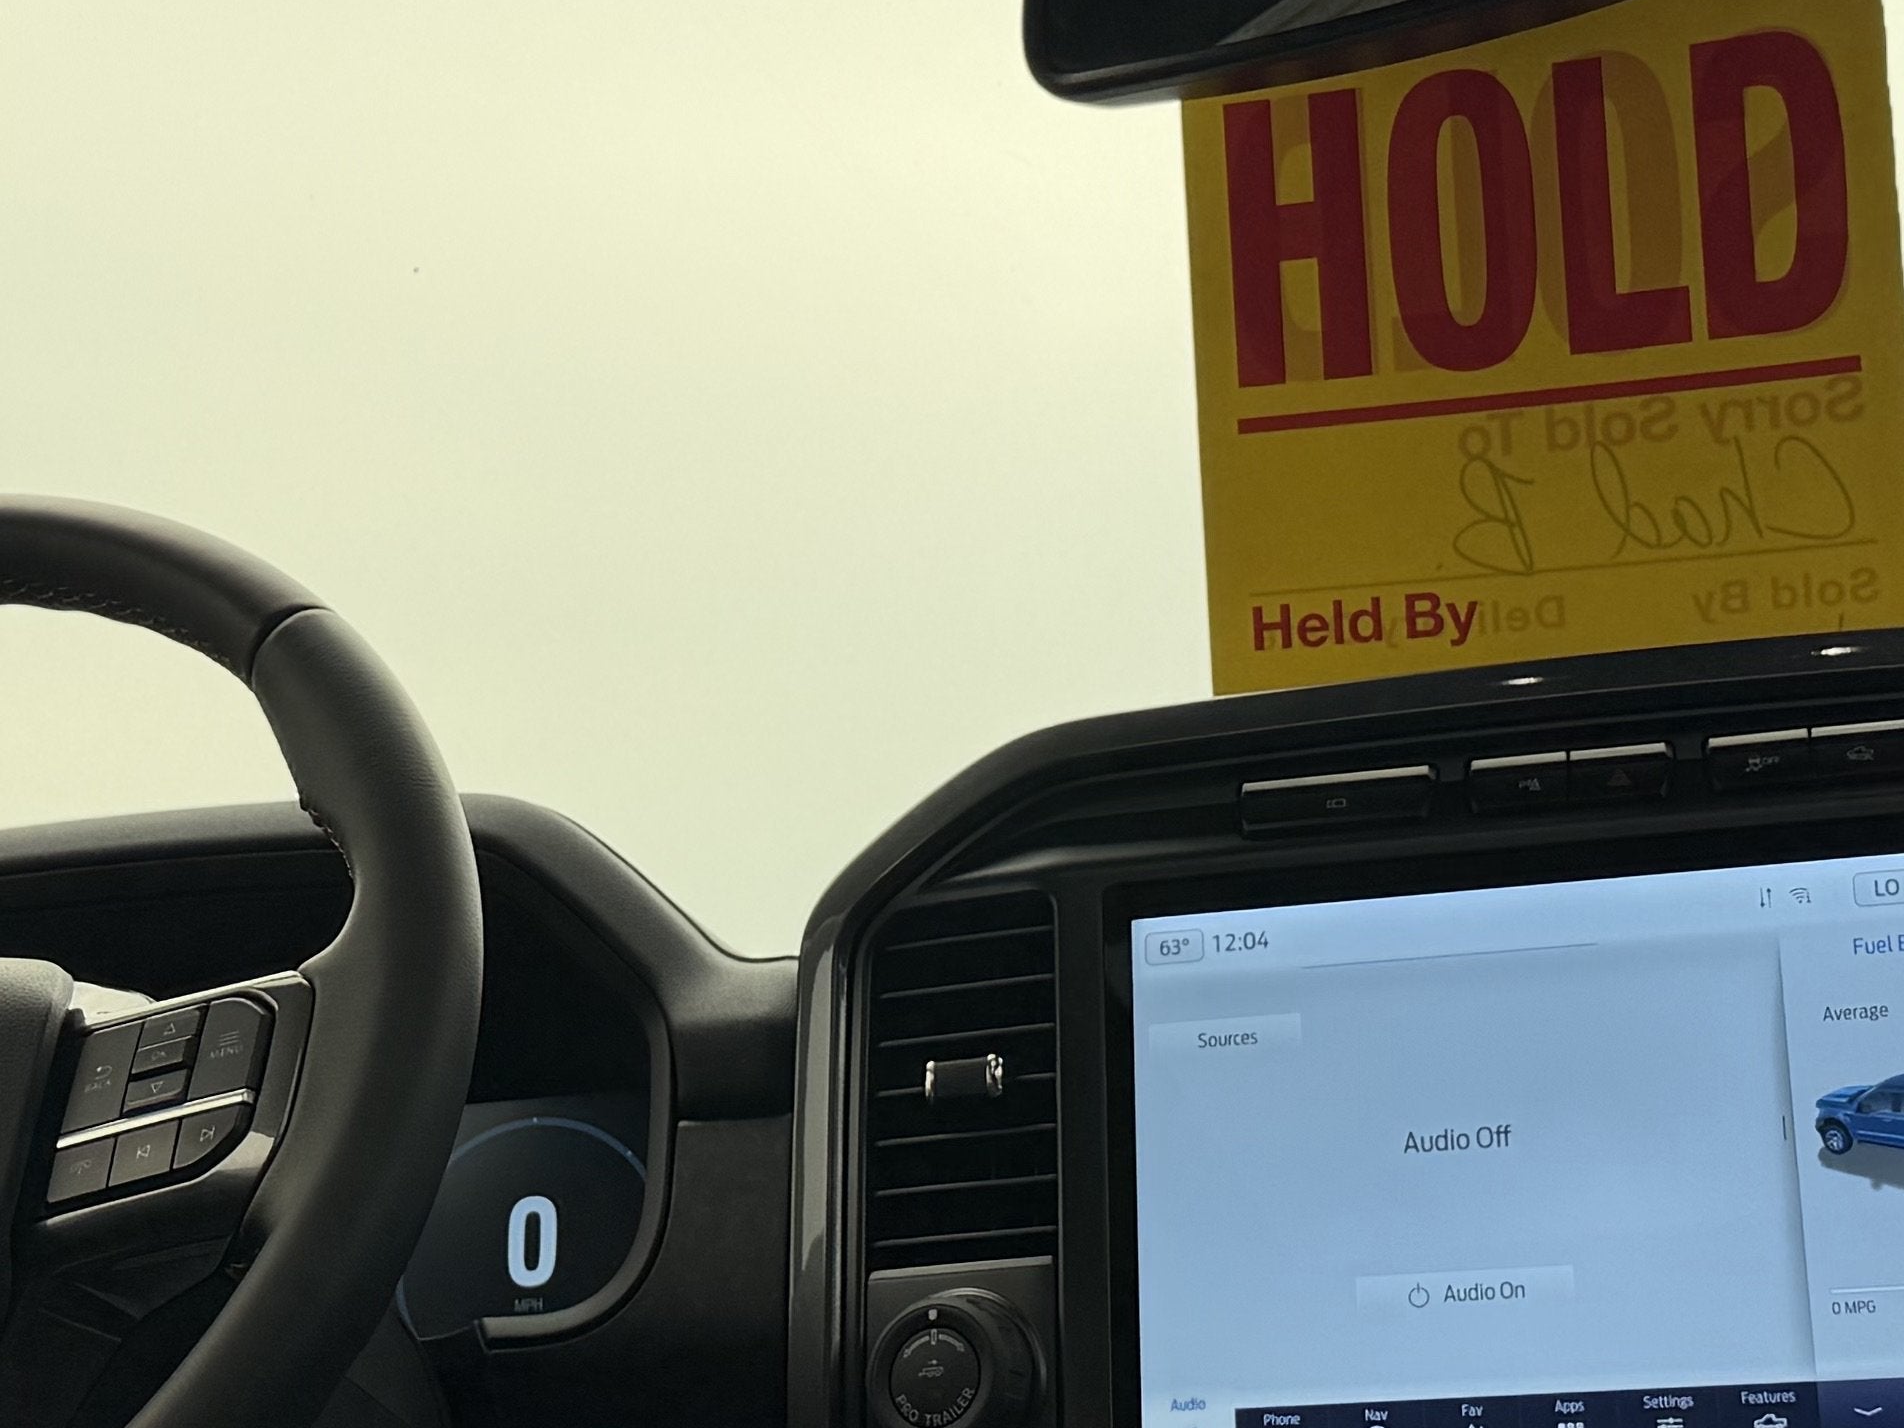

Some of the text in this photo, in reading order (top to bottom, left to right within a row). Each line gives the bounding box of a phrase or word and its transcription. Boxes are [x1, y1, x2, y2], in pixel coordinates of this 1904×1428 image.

[1223, 30, 1849, 388] HOLD
[1252, 596, 1384, 651] Held
[1405, 592, 1479, 646] By
[1873, 878, 1900, 897] LO
[1158, 938, 1191, 957] 63°
[1211, 931, 1270, 953] 12:04
[1852, 935, 1894, 955] Fuel
[1823, 1003, 1890, 1023] Average
[1197, 1030, 1259, 1049] Sources
[1403, 1124, 1512, 1154] Audio Off
[507, 1194, 558, 1289] 0
[1444, 1281, 1526, 1304] Audio On
[514, 1297, 545, 1312] MPH
[1831, 1300, 1876, 1315] 0 MPG
[895, 1386, 977, 1427] PRO TRAILER
[1171, 1398, 1207, 1412] Audio
[1554, 1399, 1586, 1416] Apps
[1642, 1395, 1695, 1412] Settings
[1740, 1391, 1797, 1406] Features
[1364, 1408, 1389, 1422] Nav
[1461, 1403, 1484, 1418] Fav
[1262, 1413, 1302, 1428] Phone
